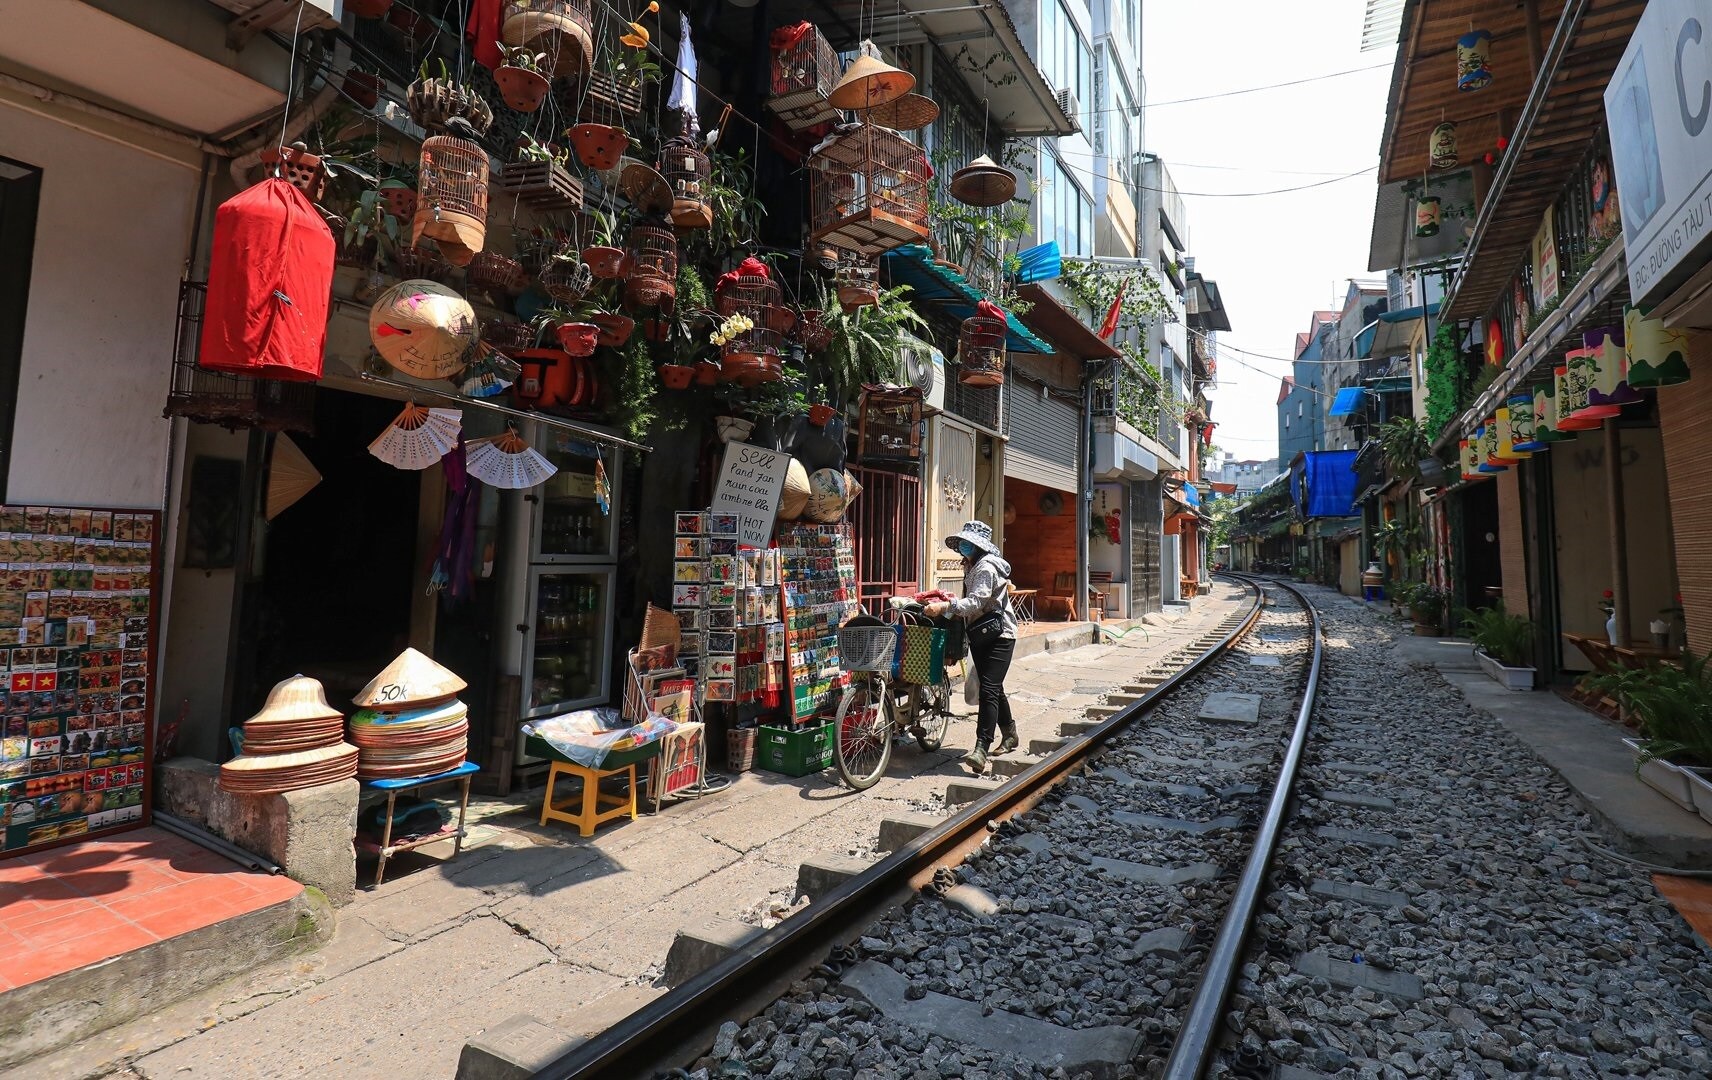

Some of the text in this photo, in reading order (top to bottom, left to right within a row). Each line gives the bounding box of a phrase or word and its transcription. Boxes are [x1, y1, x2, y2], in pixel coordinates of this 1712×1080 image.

[1682, 204, 1704, 240] TÀU
[739, 448, 776, 470] Sell
[743, 516, 765, 530] HOT
